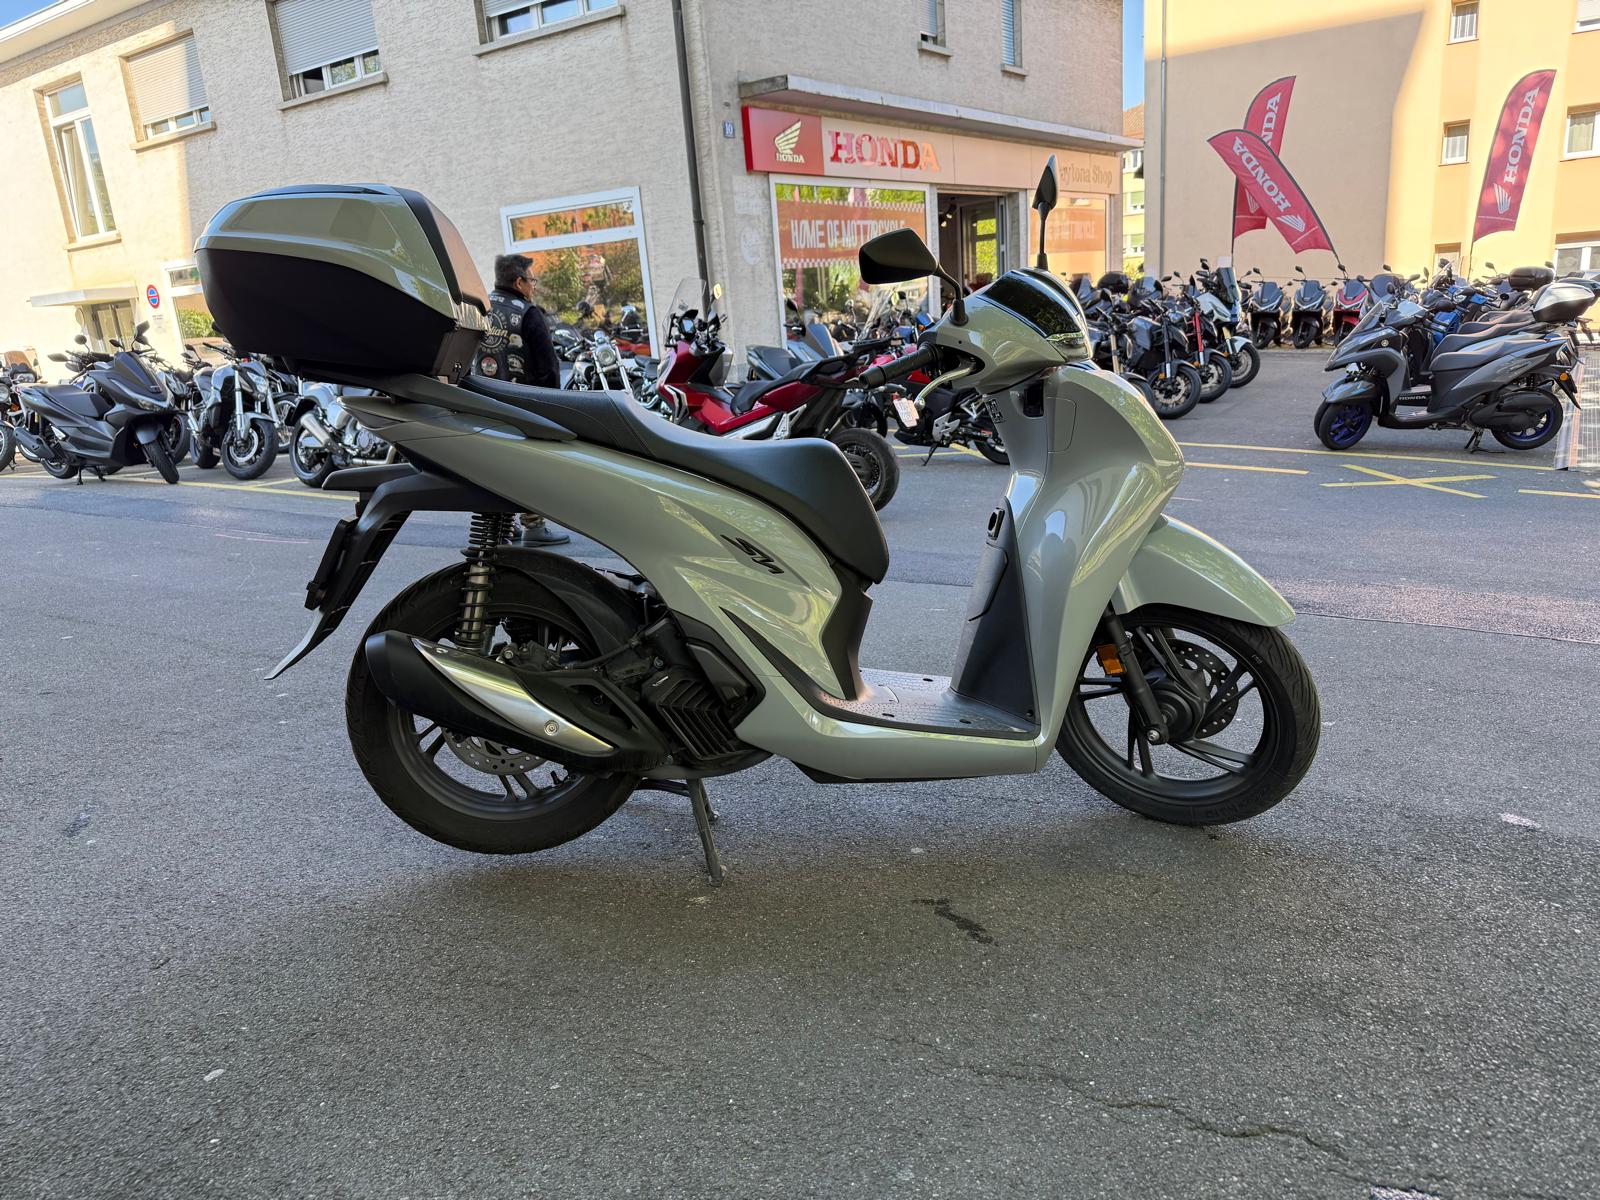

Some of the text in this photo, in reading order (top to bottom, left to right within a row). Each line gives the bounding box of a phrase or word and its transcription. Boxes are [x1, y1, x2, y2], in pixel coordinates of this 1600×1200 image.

[1261, 92, 1281, 146] NDA
[1503, 87, 1540, 185] HONDA
[776, 153, 805, 164] HONDA
[828, 130, 942, 172] HONDA
[1059, 163, 1113, 188] aytona Shop
[1232, 136, 1291, 213] HONDA
[790, 219, 826, 249] HOME
[826, 219, 840, 249] OF
